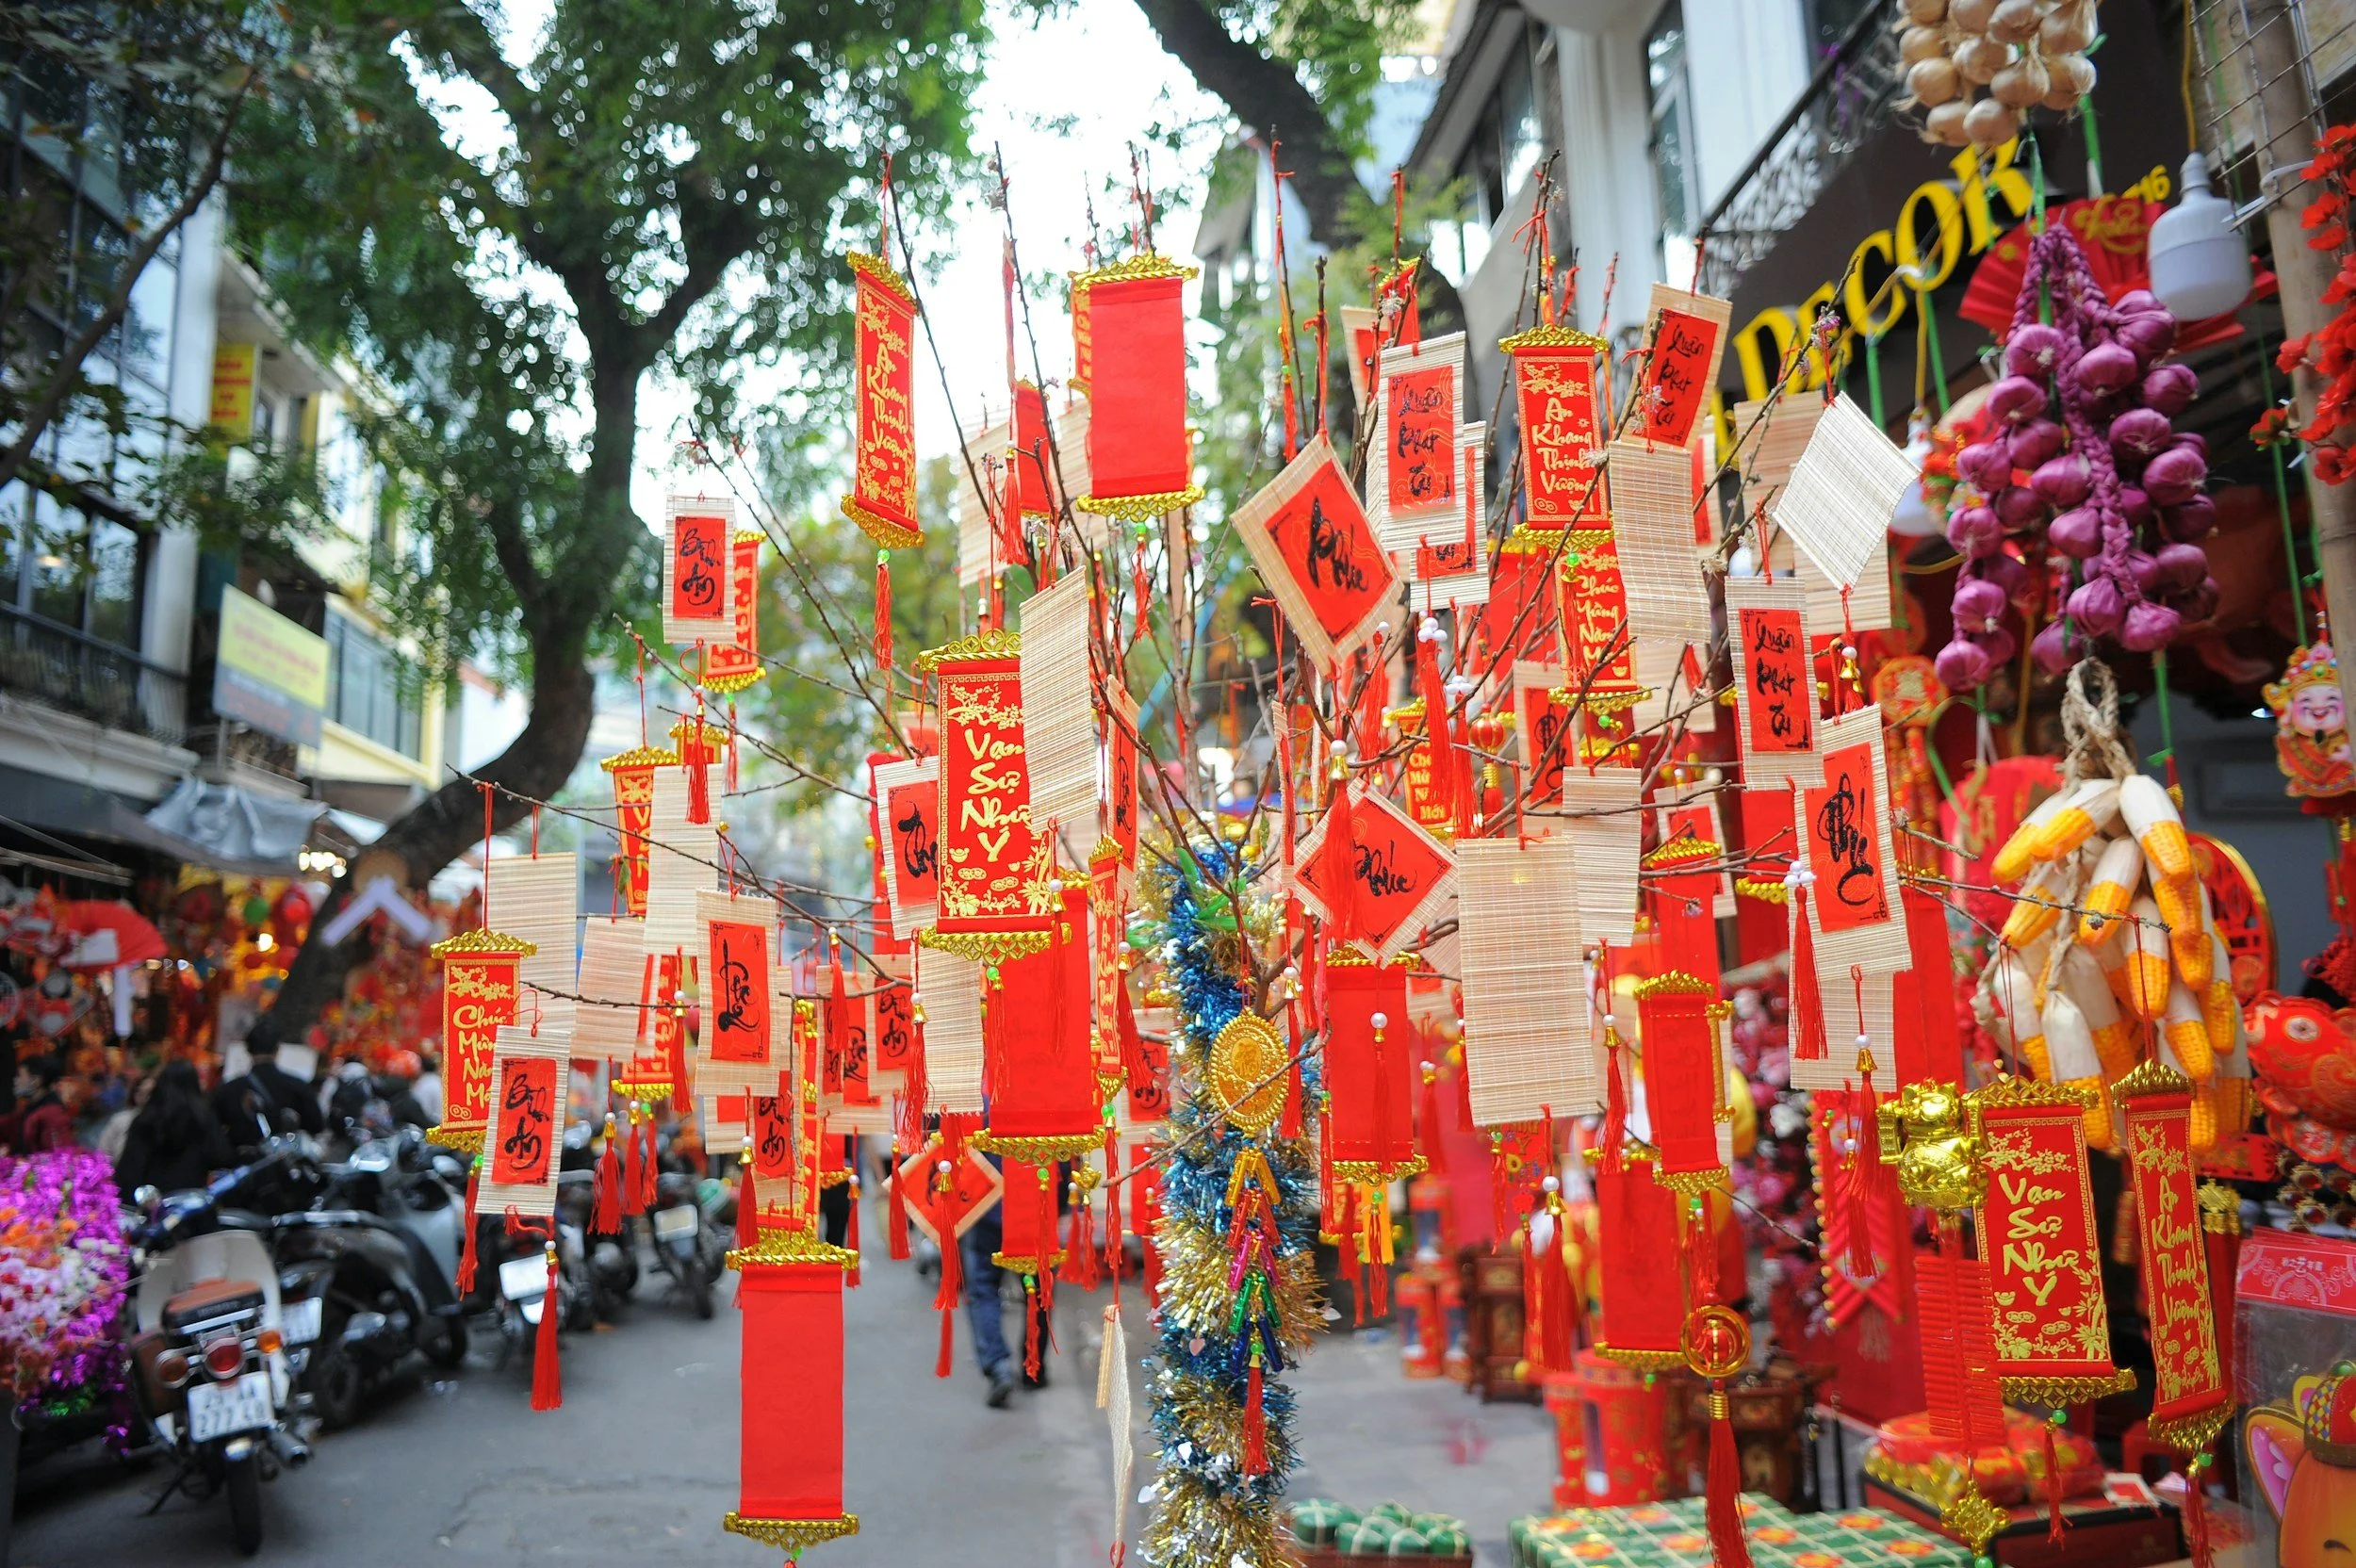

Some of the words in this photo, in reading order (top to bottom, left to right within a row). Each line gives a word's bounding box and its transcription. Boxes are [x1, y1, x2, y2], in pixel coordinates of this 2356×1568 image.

[877, 342, 897, 374] An
[866, 364, 908, 430] Khang
[1545, 397, 1574, 423] An
[1531, 424, 1593, 454] Khang
[964, 728, 1025, 760] Vạn
[968, 761, 1022, 794] Sự
[960, 796, 1031, 832] Như
[976, 825, 1010, 862] Ý
[453, 1004, 507, 1029] Chúc
[1998, 1173, 2067, 1205] Vạn
[2159, 1175, 2180, 1214] An
[2007, 1206, 2063, 1239] Sự
[2003, 1240, 2080, 1276] Như
[2151, 1215, 2198, 1271] Khang
[2022, 1271, 2057, 1306] Ý
